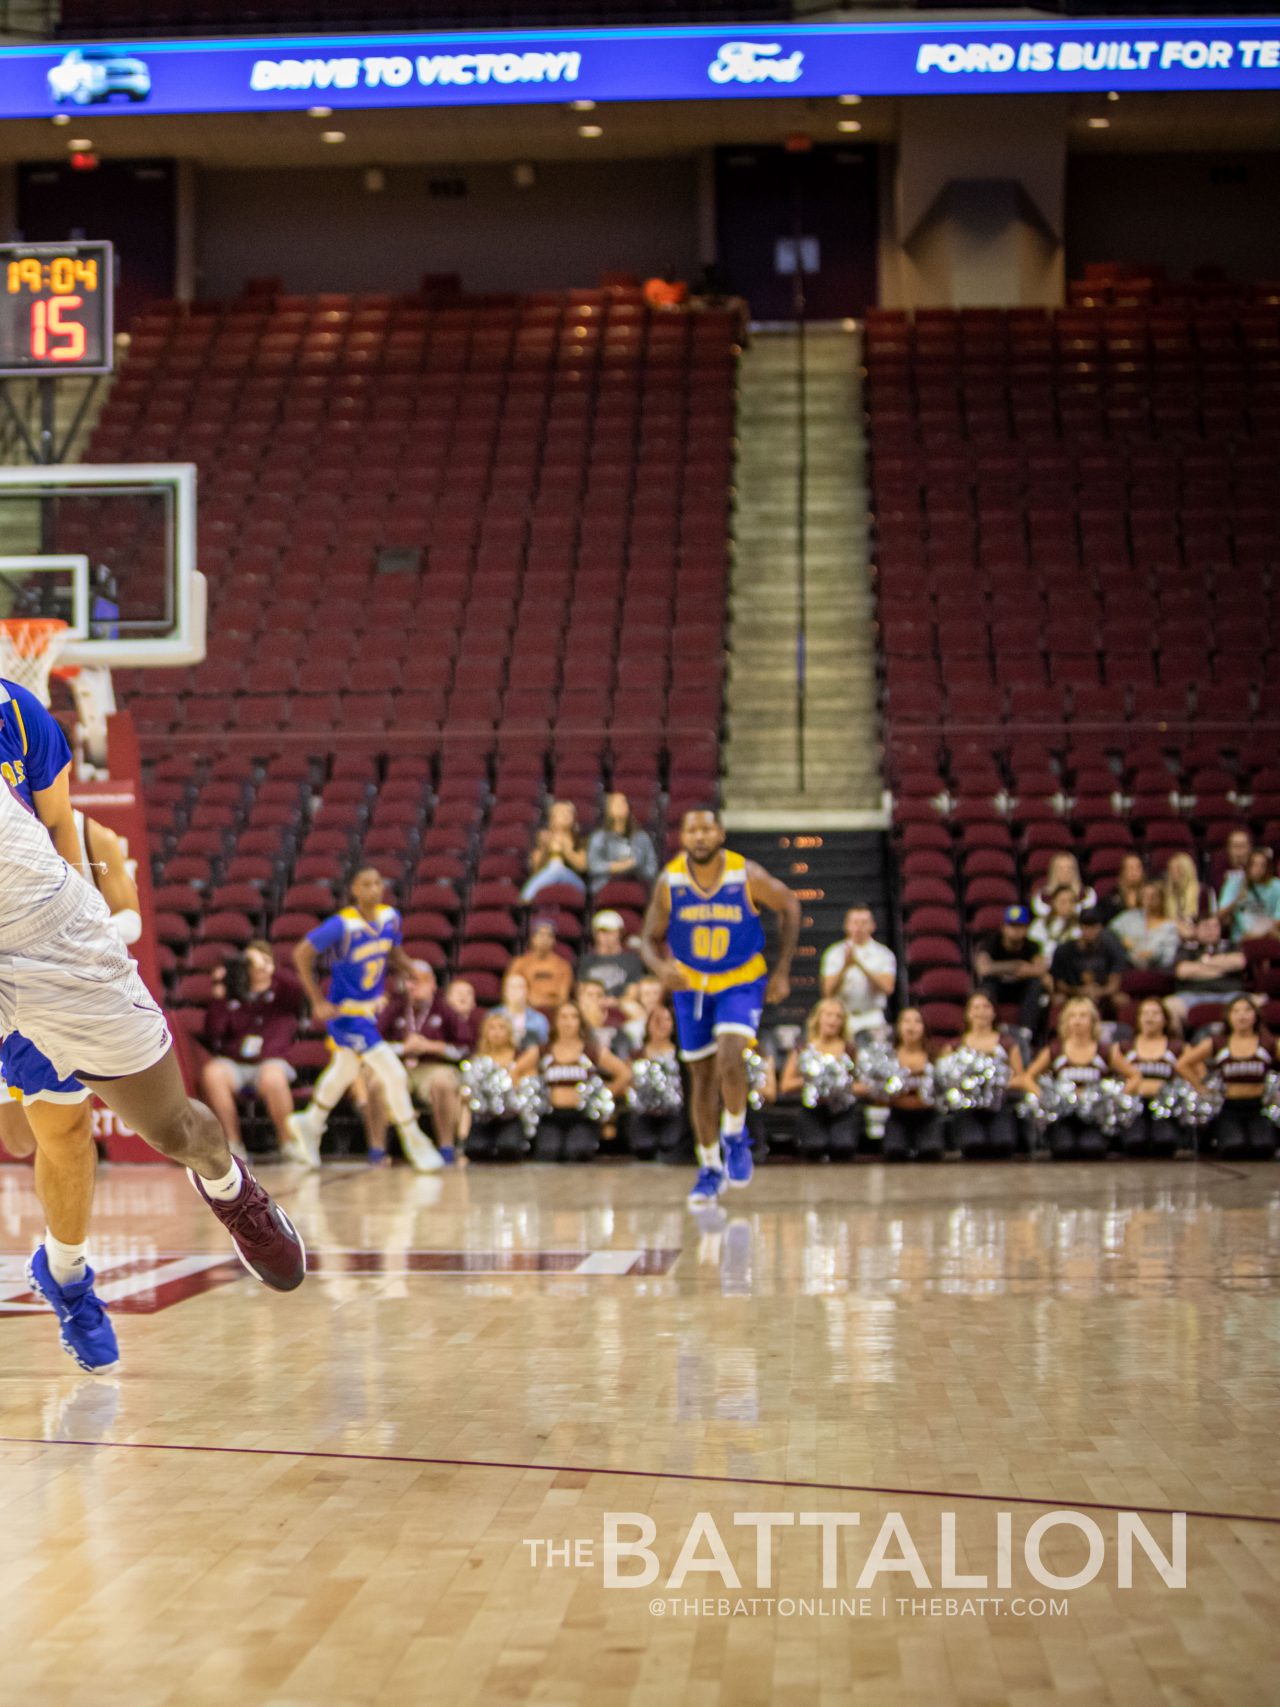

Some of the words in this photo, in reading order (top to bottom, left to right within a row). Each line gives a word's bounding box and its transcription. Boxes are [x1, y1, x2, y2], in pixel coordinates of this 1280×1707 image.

[250, 58, 361, 91] DRIVE
[363, 56, 413, 88] TO
[415, 51, 581, 86] VICTORY!
[708, 41, 804, 84] Ford
[916, 43, 1015, 73] FORD
[1017, 42, 1054, 72] IS
[1057, 41, 1159, 71] BUILT
[1160, 40, 1233, 70] FOR
[7, 257, 97, 294] 19:04
[31, 294, 86, 361] 15
[691, 925, 731, 961] 00
